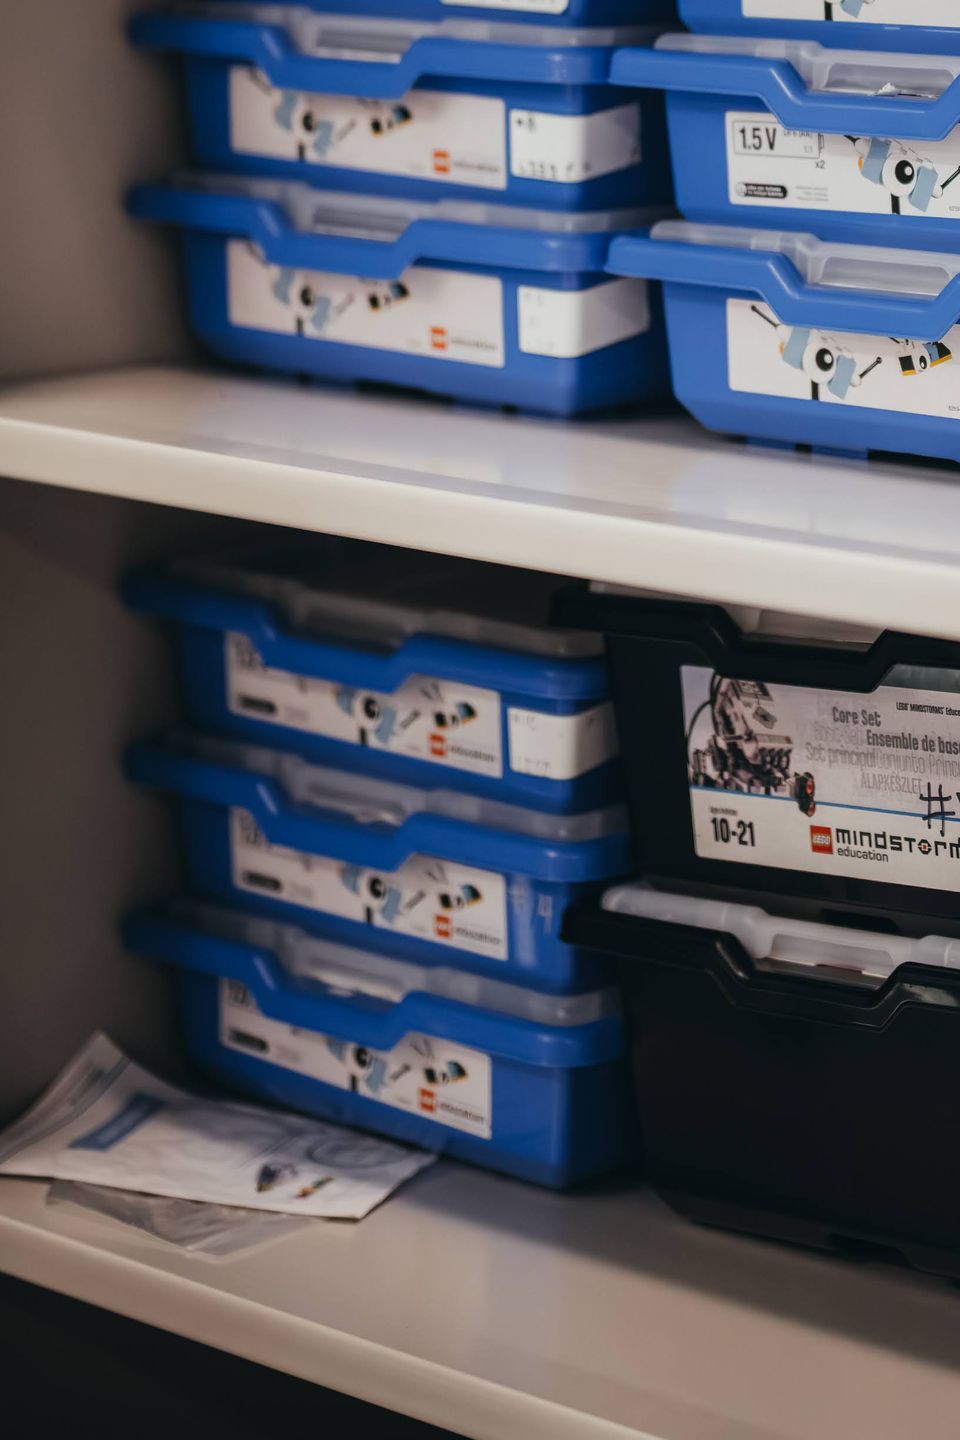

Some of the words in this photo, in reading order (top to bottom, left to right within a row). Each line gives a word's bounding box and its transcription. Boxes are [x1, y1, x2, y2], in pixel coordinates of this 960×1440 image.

[739, 126, 762, 150] 1.5
[766, 128, 776, 151] V
[832, 706, 858, 724] Core
[861, 711, 881, 727] Set
[866, 729, 918, 751] Ensemble
[922, 734, 936, 752] de
[711, 817, 756, 847] 10-21
[837, 846, 889, 863] education
